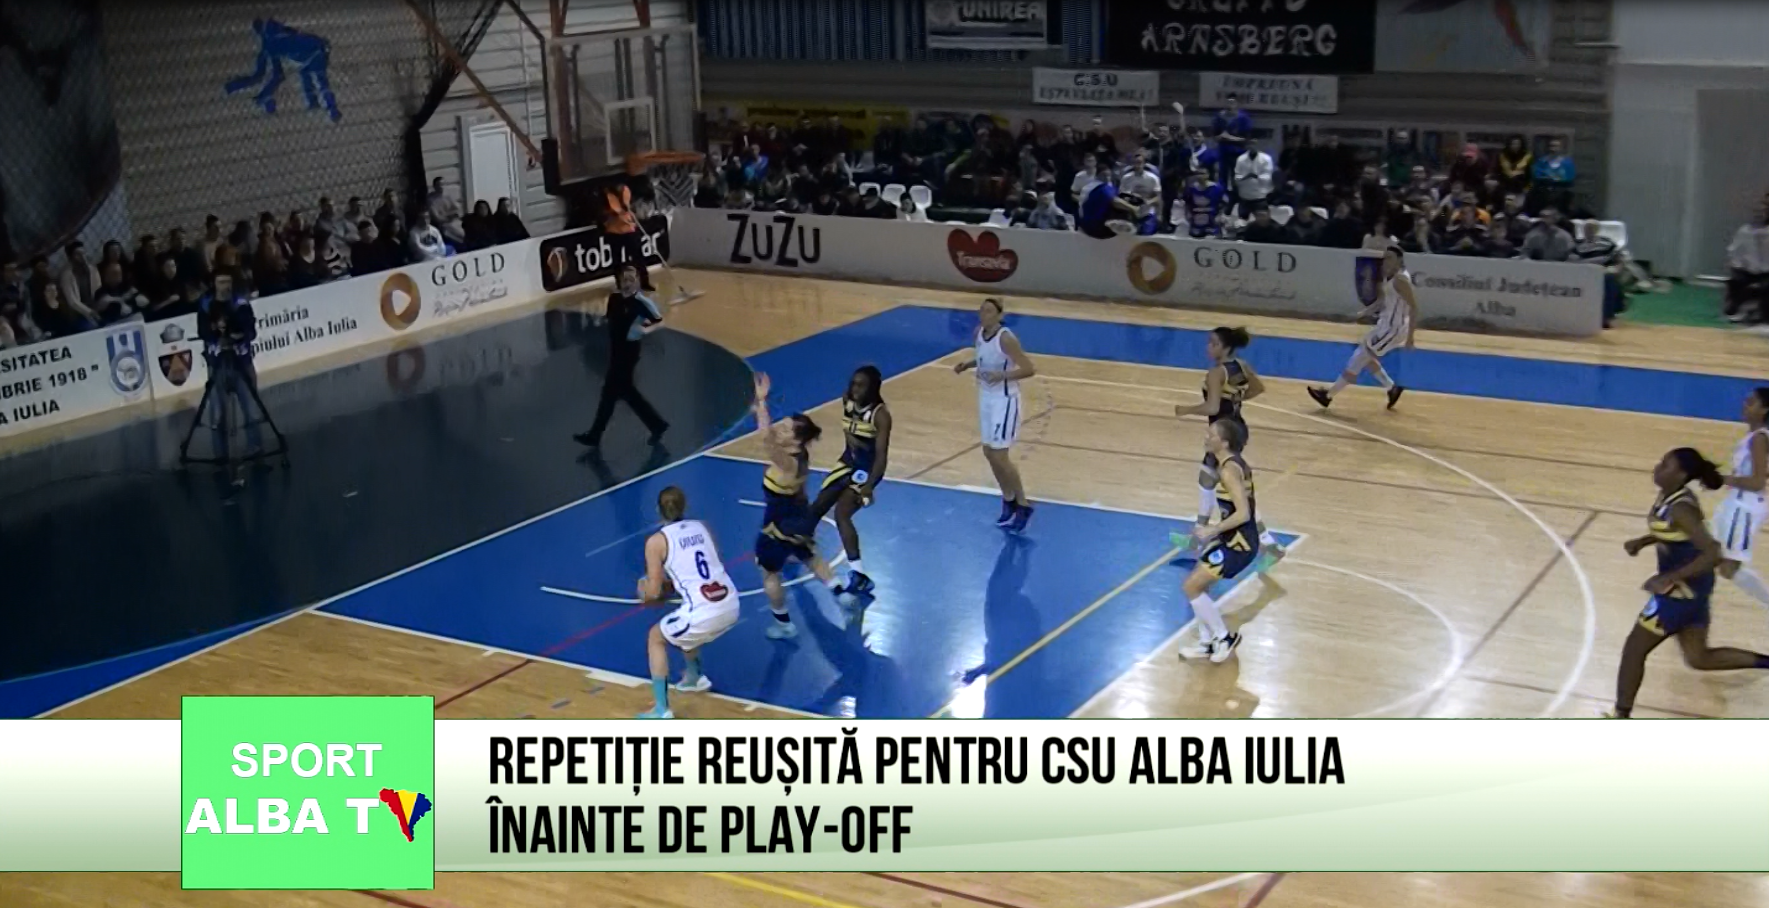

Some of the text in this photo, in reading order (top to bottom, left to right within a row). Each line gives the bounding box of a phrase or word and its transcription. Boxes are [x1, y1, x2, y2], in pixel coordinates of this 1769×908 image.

[1141, 23, 1337, 56] ARNSBERG
[574, 229, 665, 274] tobar
[1194, 246, 1297, 273] GOLD
[431, 252, 505, 287] GOLD
[255, 306, 309, 330] rimăria
[295, 324, 324, 343] Alba
[327, 316, 358, 336] Iulia
[0, 377, 42, 399] BRIE
[49, 366, 87, 388] 1918
[13, 399, 60, 422] IULIA
[695, 550, 710, 580] 6
